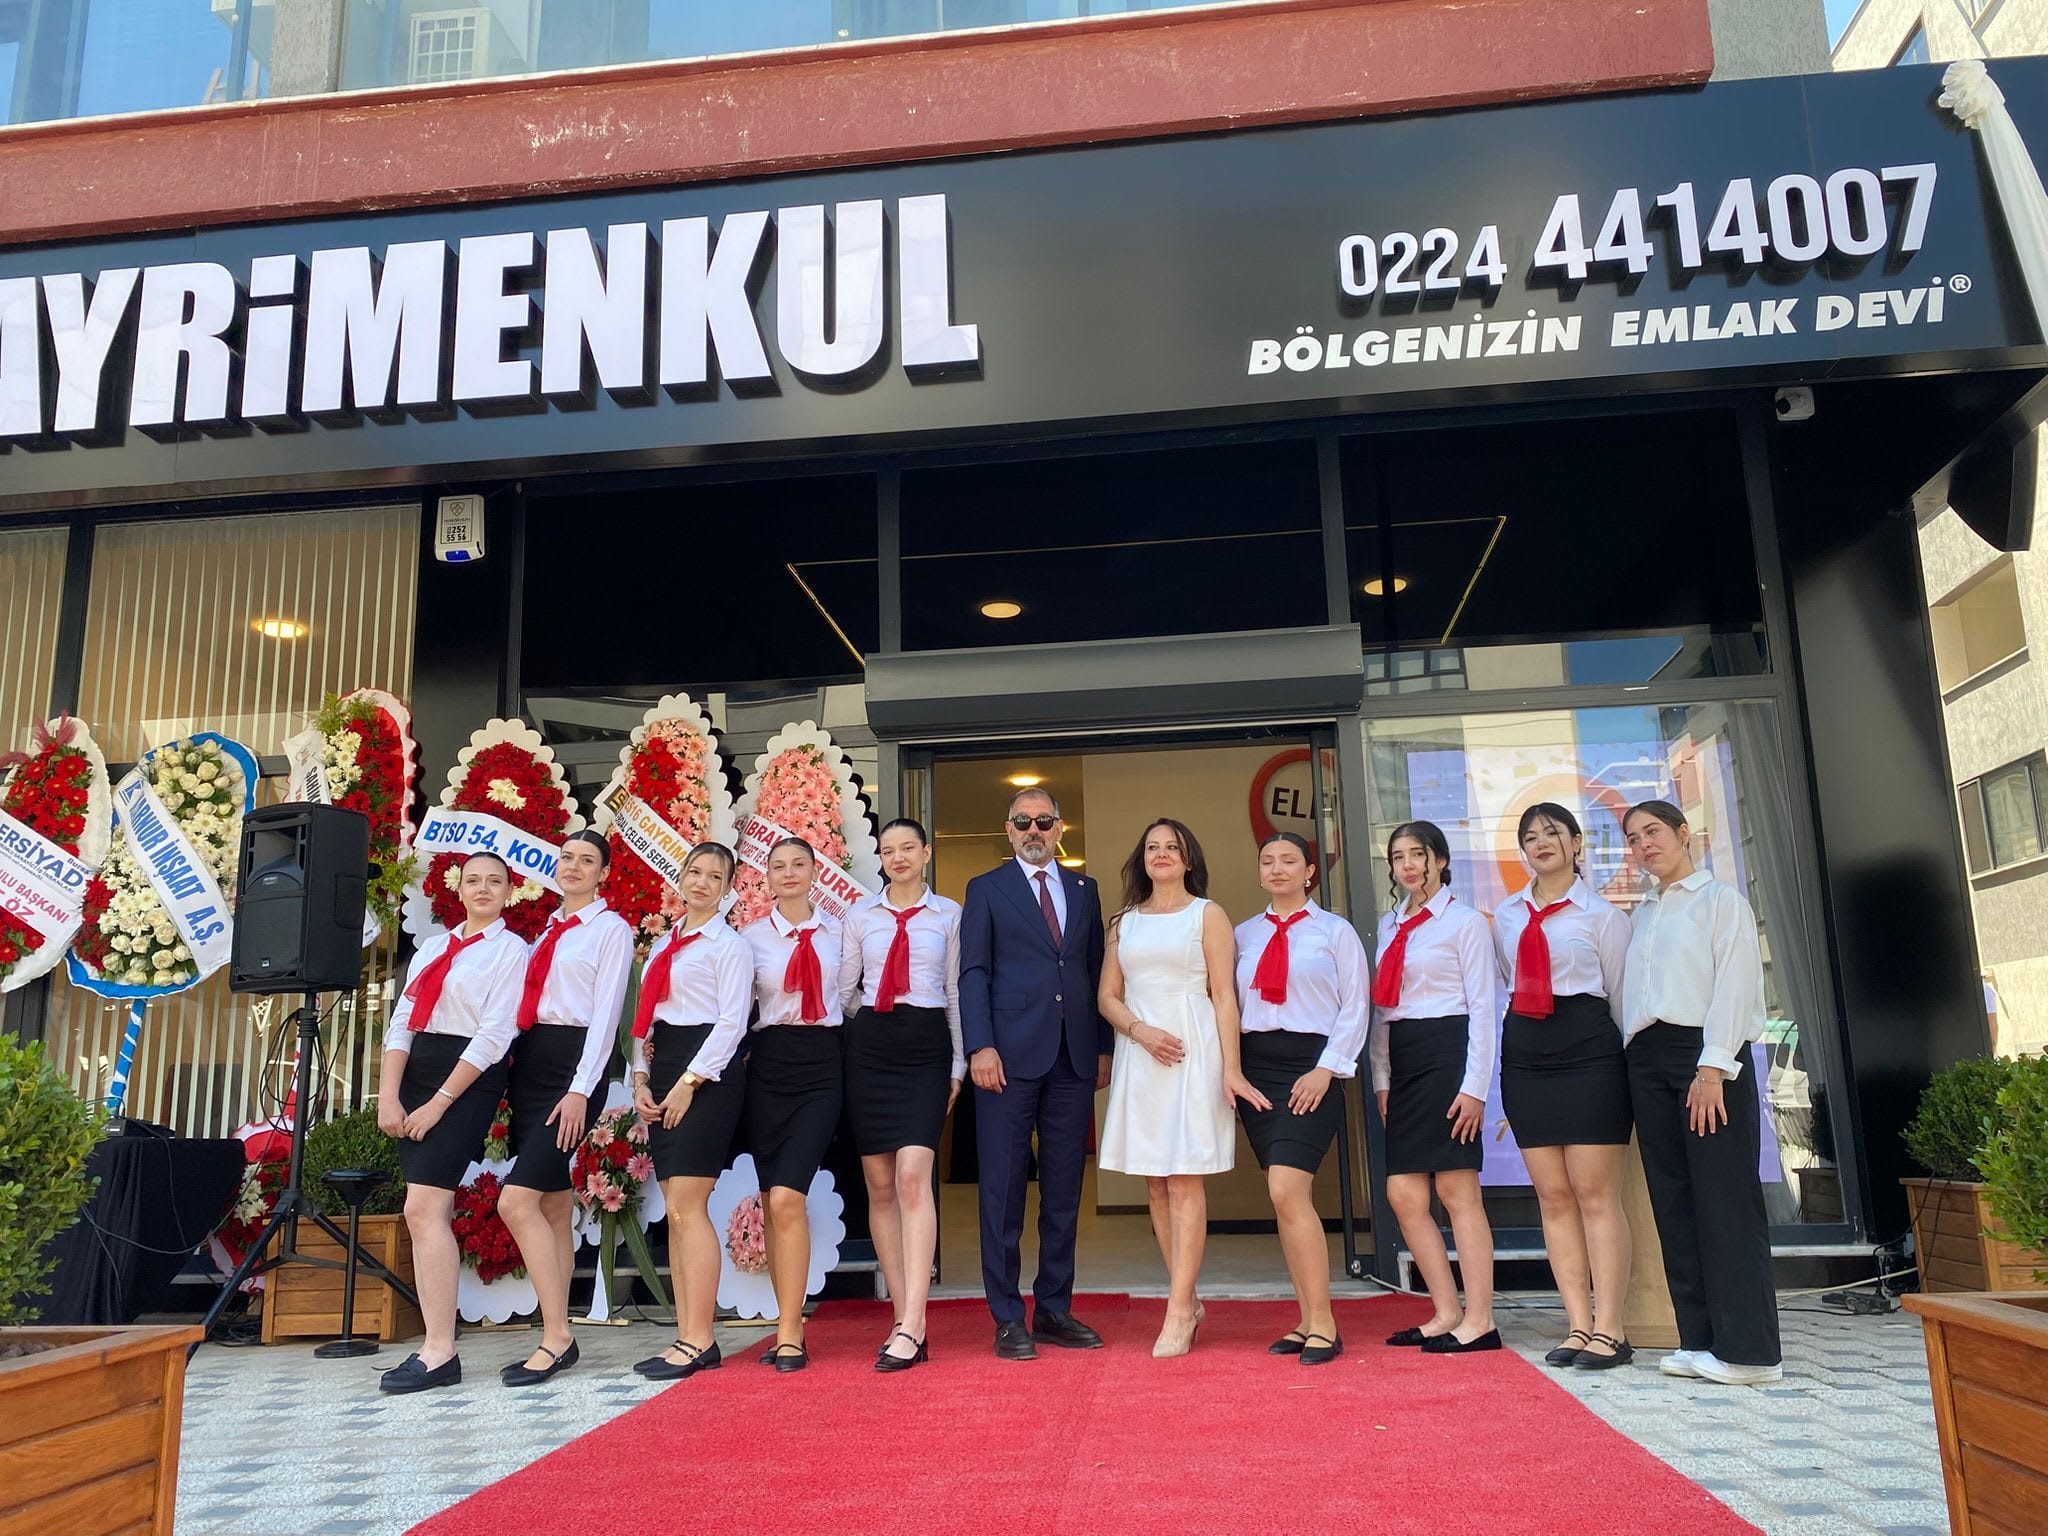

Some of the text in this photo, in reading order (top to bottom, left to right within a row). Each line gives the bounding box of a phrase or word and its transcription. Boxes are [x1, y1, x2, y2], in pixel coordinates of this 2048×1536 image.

[1339, 162, 1938, 297] 0224 4414007
[1247, 309, 1582, 376] BÖLGENİZİN
[1610, 297, 1798, 348] EMLAK
[423, 820, 467, 843] BTSO
[467, 824, 500, 853] 54.
[639, 815, 688, 866] GAYRİM
[149, 838, 207, 901] İNŞAAT
[15, 883, 70, 924] BAŞKANI
